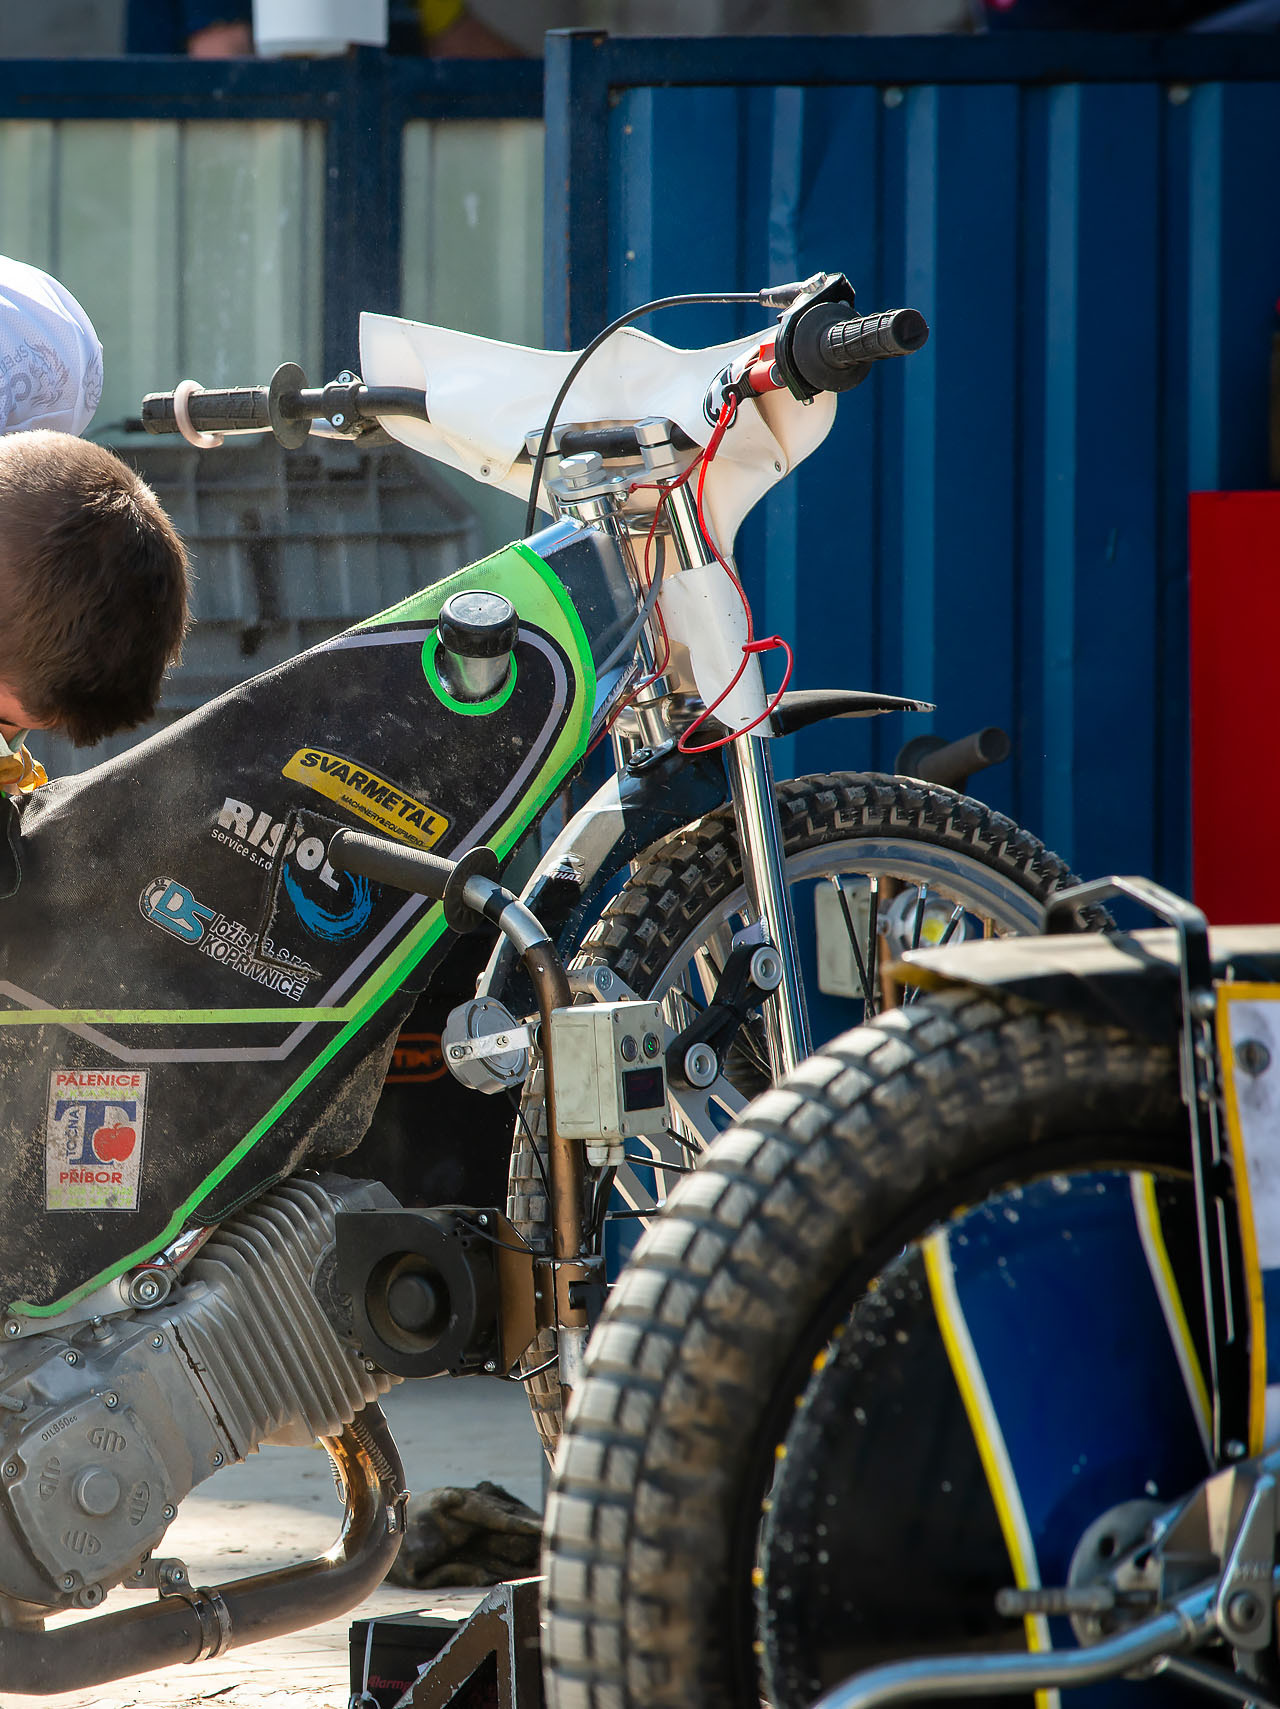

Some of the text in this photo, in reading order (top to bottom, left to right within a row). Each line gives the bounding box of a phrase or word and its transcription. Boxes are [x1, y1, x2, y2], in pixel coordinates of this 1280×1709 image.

[300, 752, 436, 836] SVARMETAL
[211, 828, 250, 857] service
[60, 1168, 123, 1185] PŘÍBOR
